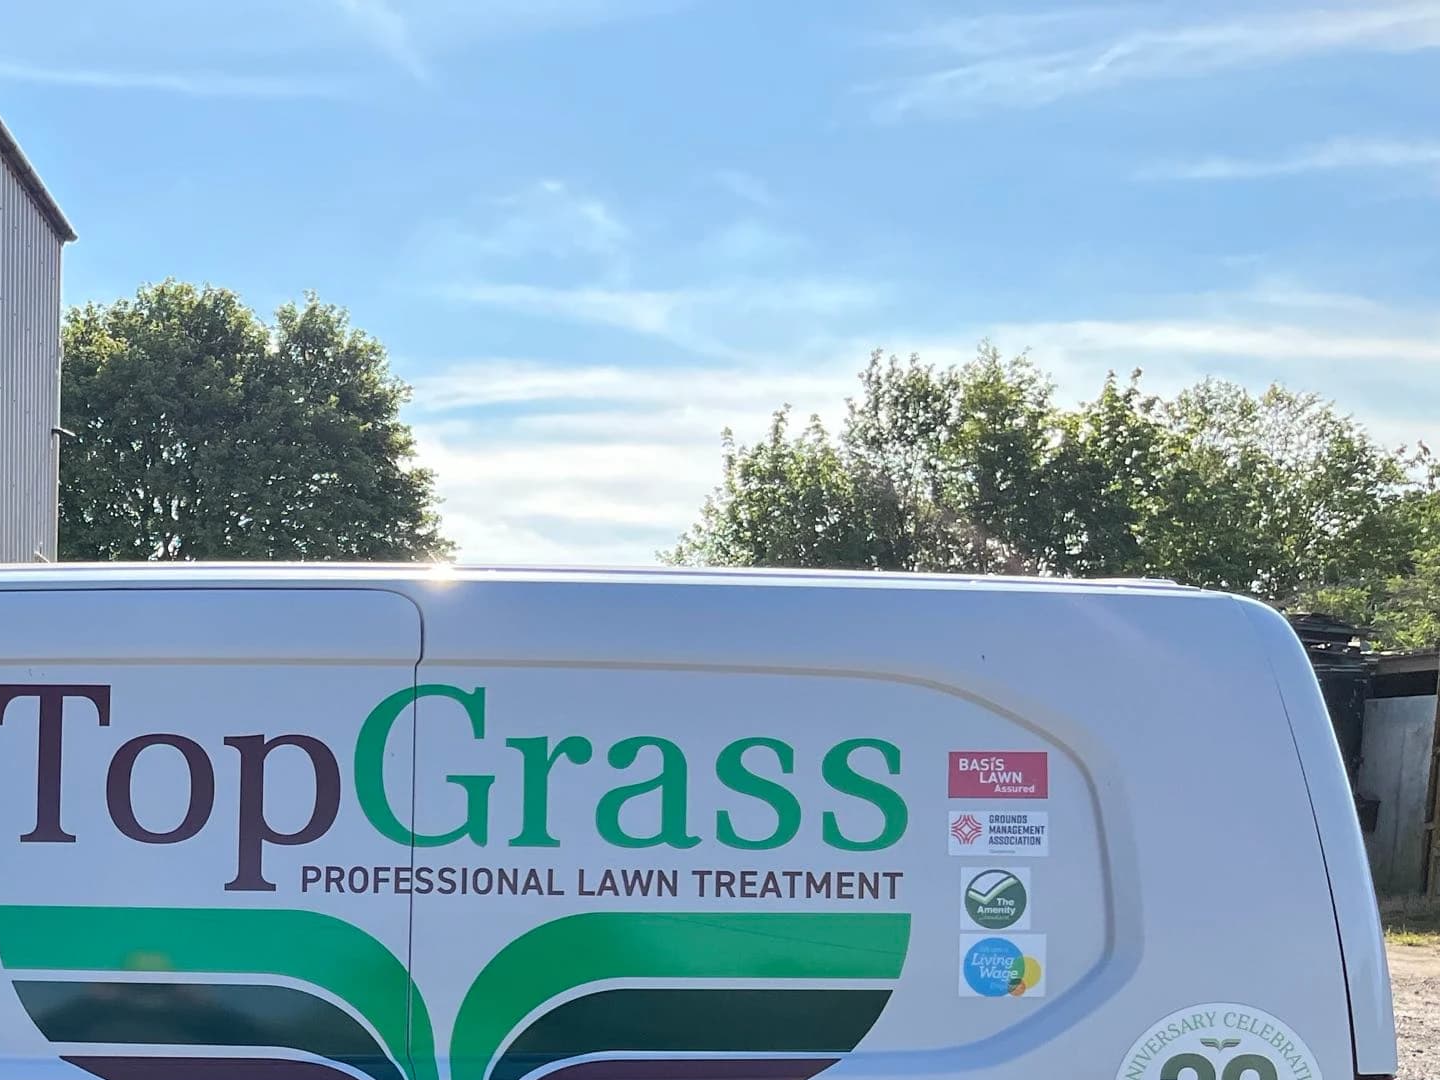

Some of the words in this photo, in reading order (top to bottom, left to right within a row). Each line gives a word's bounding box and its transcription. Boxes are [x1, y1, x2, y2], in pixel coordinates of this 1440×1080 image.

[980, 772, 1023, 784] LAWN
[994, 784, 1035, 794] Assured
[989, 815, 1028, 824] GROUNDS
[989, 825, 1045, 835] MANAGEMENT
[989, 836, 1041, 846] ASSOCIATION
[302, 866, 564, 896] PROFESSIONAL
[578, 870, 678, 897] LAWN
[691, 870, 904, 899] TREATMENT
[997, 898, 1015, 906] The
[977, 906, 1016, 916] Amenity
[971, 953, 1014, 969] Living
[979, 966, 1018, 982] Wage
